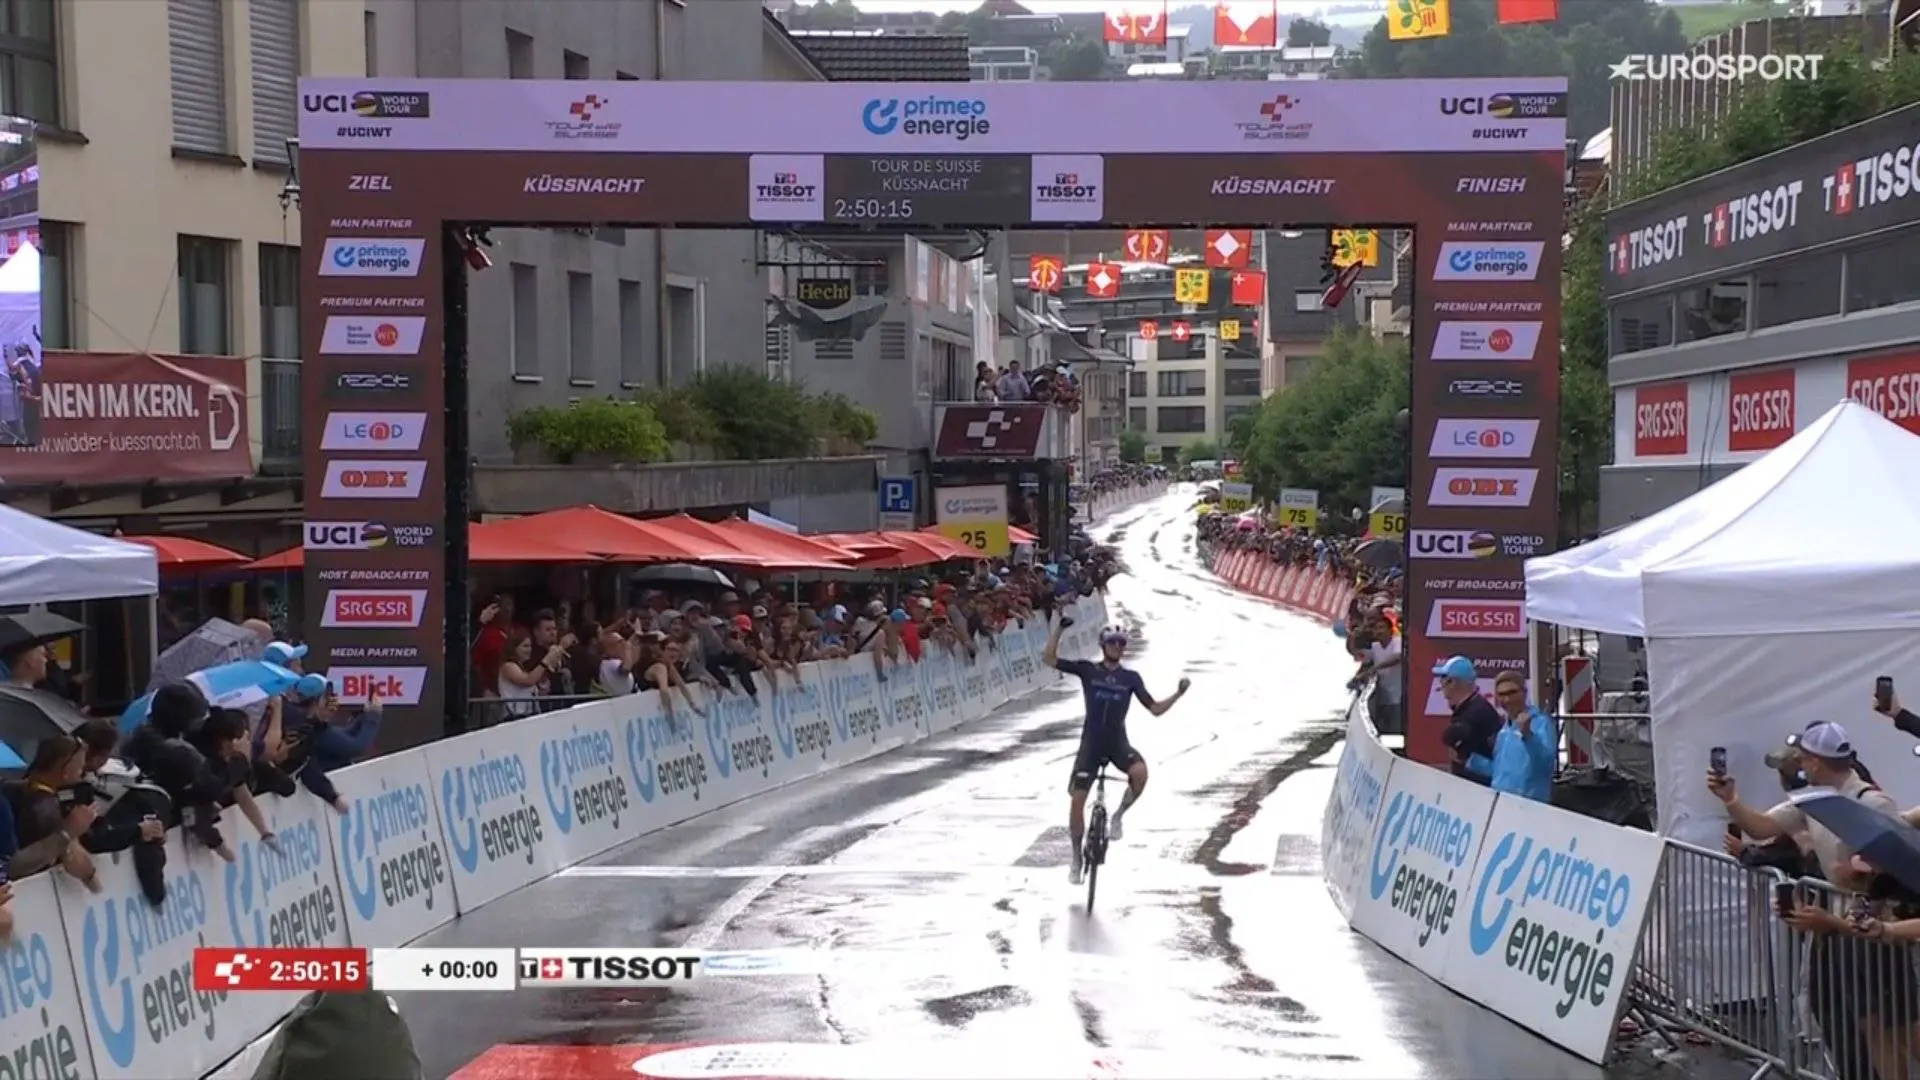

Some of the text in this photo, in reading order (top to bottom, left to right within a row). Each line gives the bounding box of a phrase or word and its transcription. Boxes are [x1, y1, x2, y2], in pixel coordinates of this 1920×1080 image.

[304, 95, 347, 112] UCI
[381, 96, 419, 106] WORLD
[383, 105, 410, 114] TOUR
[904, 95, 986, 118] primeo
[1441, 97, 1483, 115] UCI
[1519, 96, 1557, 106] WORLD
[1520, 105, 1547, 115] TOUR
[337, 127, 392, 138] #UCIWT
[904, 115, 990, 140] energie
[1472, 128, 1528, 139] #UCIWT
[871, 159, 982, 173] TOUR DE SUISSE
[348, 175, 393, 190] ZIEL
[523, 174, 646, 193] KÜSSNACHT
[883, 176, 969, 191] KÜSSNACHT
[1855, 143, 1920, 208] TISSO
[757, 185, 816, 197] TISSOT
[1037, 186, 1096, 197] TISSOT
[1211, 176, 1335, 194] KÜSSNACHT
[1456, 177, 1527, 193] FINISH
[835, 199, 913, 219] 2:50:15
[1728, 180, 1803, 243] TISSOT
[331, 219, 413, 228] MAIN PARTNER
[1447, 222, 1533, 231] MAIN PARTNER
[358, 244, 406, 258] primeo
[1630, 216, 1688, 270] TISSOT
[1474, 248, 1526, 262] primeo
[358, 257, 410, 271] energie
[1474, 261, 1528, 275] energie
[798, 283, 850, 300] Hecht
[320, 298, 425, 307] PREMIUM PARTNER
[1434, 303, 1543, 312] PREMIUM PARTNER
[42, 382, 200, 419] NEN IM KERN.
[1637, 398, 1684, 439] SRG SSR
[1733, 389, 1790, 434] SRG SSR
[15, 432, 201, 453] w.widder-kuessnacht.ch
[340, 471, 408, 487] OBI
[1448, 479, 1518, 496] OBI
[886, 483, 903, 507] P
[1226, 500, 1246, 510] 100
[1288, 509, 1306, 523] 75
[1383, 515, 1405, 533] 50
[310, 526, 356, 544] UCI
[393, 527, 433, 536] WORLD
[960, 530, 987, 550] 25
[395, 536, 424, 545] TOUR
[1416, 534, 1463, 553] UCI
[1502, 536, 1543, 545] WORLD
[1504, 545, 1533, 554] TOUR
[319, 570, 430, 580] HOST BROADCASTER
[1425, 580, 1525, 590] HOST BROADCAST
[340, 602, 408, 616] SRG SSR
[1446, 611, 1516, 626] SRG SSR
[331, 648, 418, 657] MEDIA PARTNER
[1474, 658, 1526, 668] PARTNER
[343, 675, 404, 697] Blick
[562, 725, 615, 784] primeo
[658, 743, 708, 801] energie
[468, 748, 527, 816] primeo
[573, 766, 629, 829] energie
[368, 778, 428, 856] primeo
[481, 796, 543, 865] energie
[1404, 793, 1473, 868] primeo
[379, 831, 445, 910] energie
[1521, 837, 1631, 928] primeo
[1391, 863, 1458, 948] energie
[0, 932, 52, 1019] meo
[1505, 917, 1614, 1020] energie
[142, 931, 228, 1044] energ
